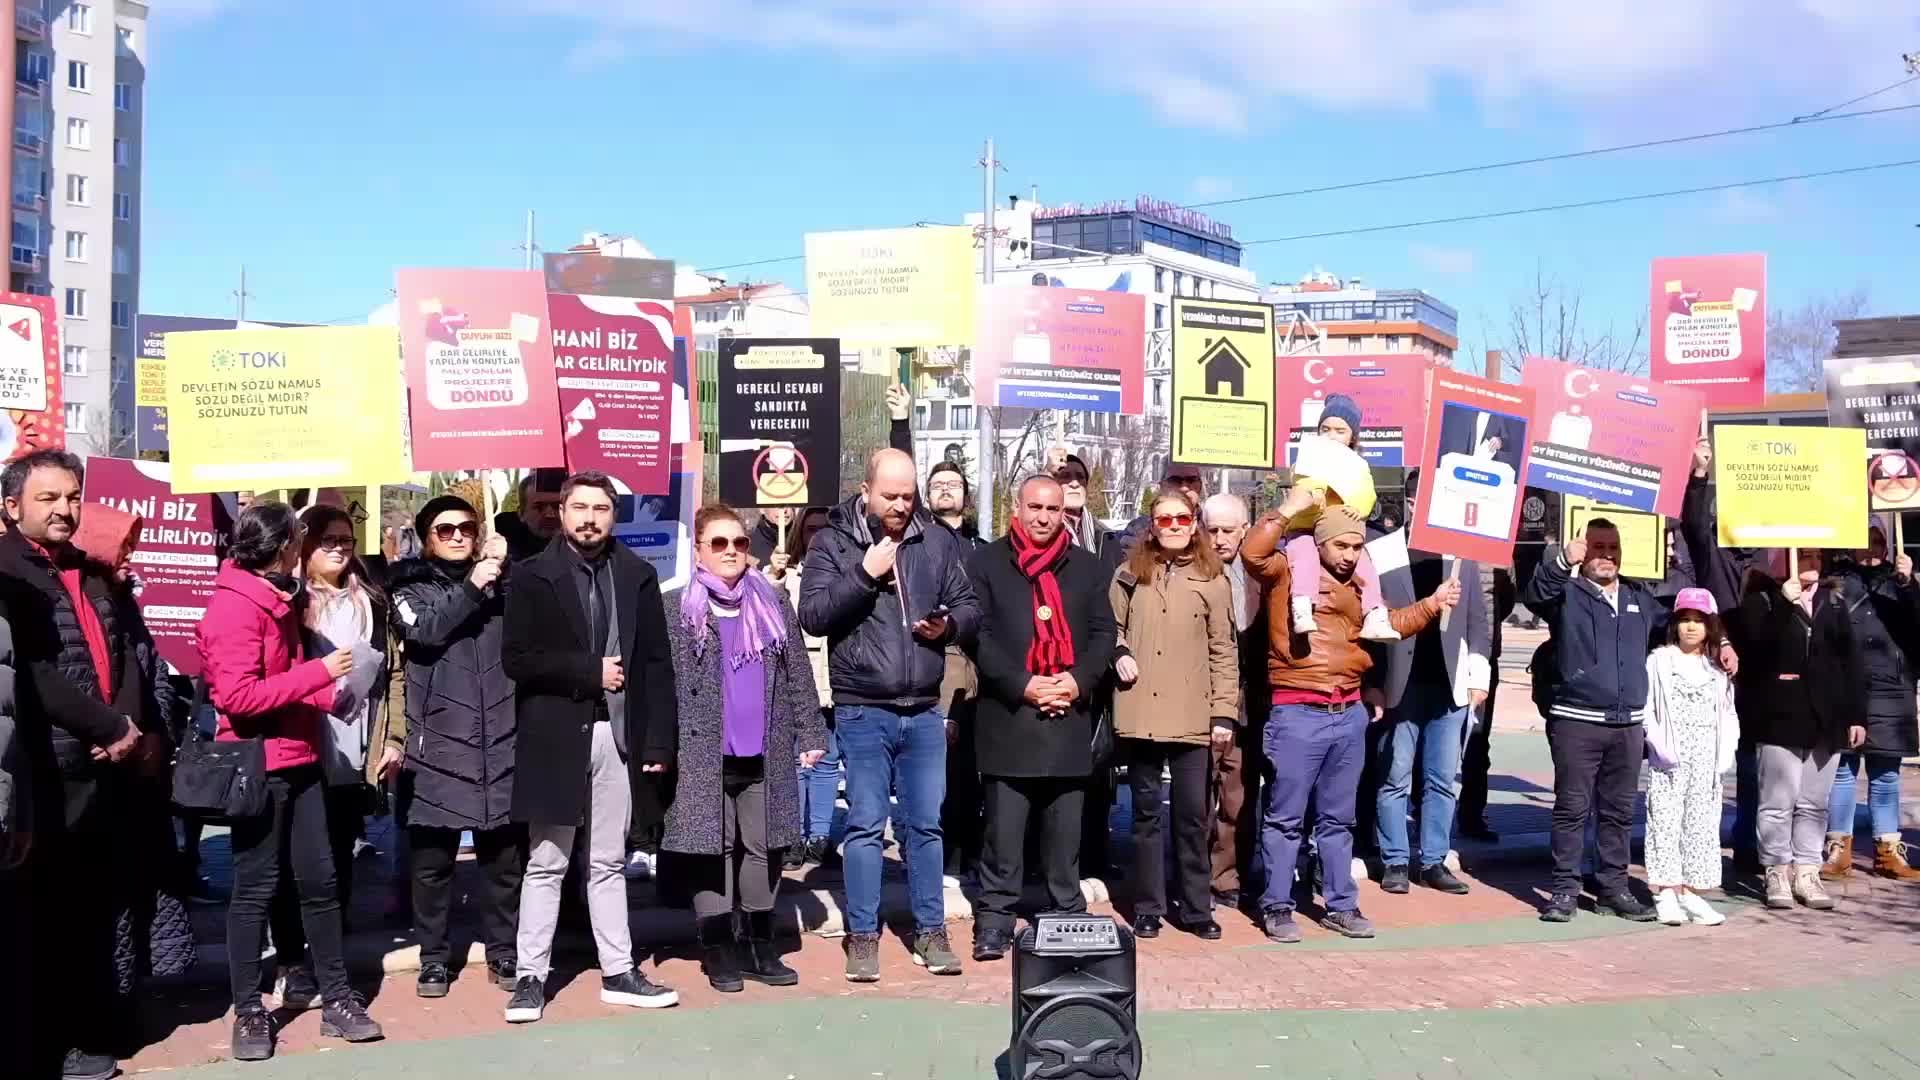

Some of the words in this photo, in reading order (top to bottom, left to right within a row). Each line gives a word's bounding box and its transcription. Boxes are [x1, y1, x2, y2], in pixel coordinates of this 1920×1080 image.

[553, 327, 600, 349] HANİ
[608, 328, 638, 350] BİZ
[555, 355, 574, 369] AR
[278, 379, 321, 390] NAMUS
[784, 383, 823, 394] CEVABI
[269, 405, 308, 415] TUTUN
[754, 400, 807, 412] SANDIKTA
[1863, 411, 1914, 424] SANDIKTA
[163, 498, 198, 521] BİZ
[139, 526, 228, 547] ELİRLİYDİK
